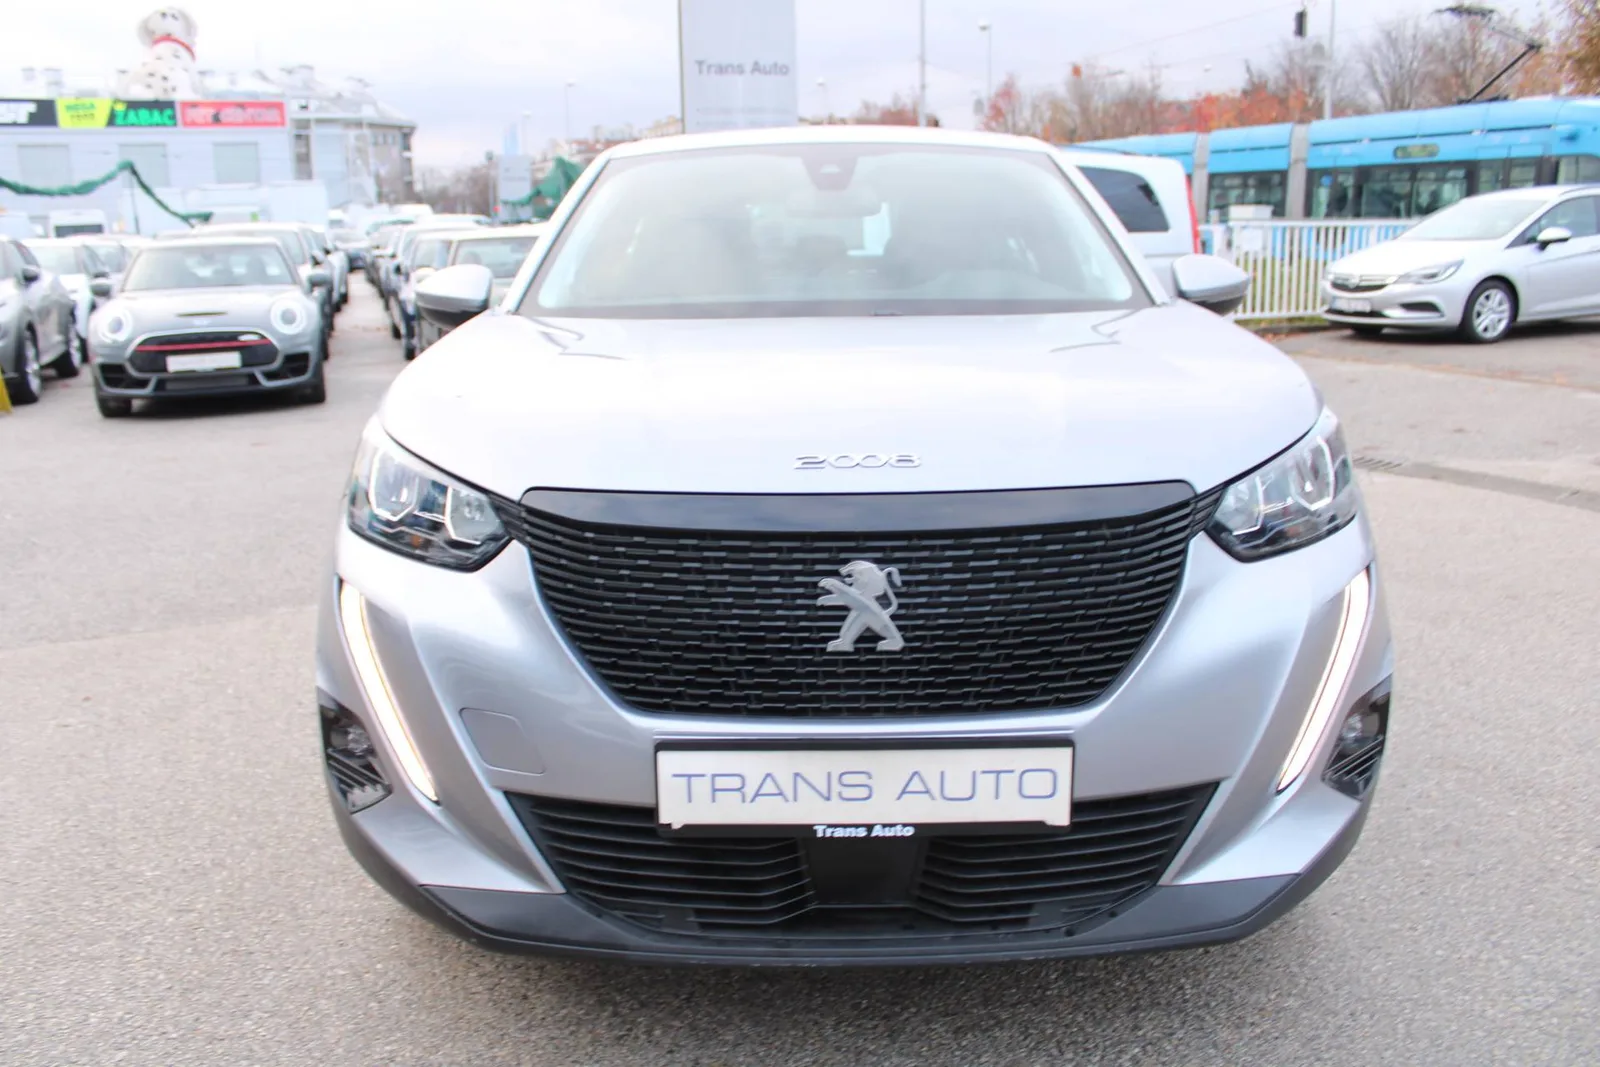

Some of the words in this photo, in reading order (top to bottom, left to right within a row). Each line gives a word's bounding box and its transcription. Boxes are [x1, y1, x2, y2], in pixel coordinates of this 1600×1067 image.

[695, 60, 745, 76] Trans
[750, 60, 790, 76] Auto
[794, 453, 922, 470] 2008
[671, 769, 874, 804] TRANS
[895, 767, 1058, 802] AUTO
[813, 824, 868, 838] Trans
[870, 824, 915, 837] Auto
